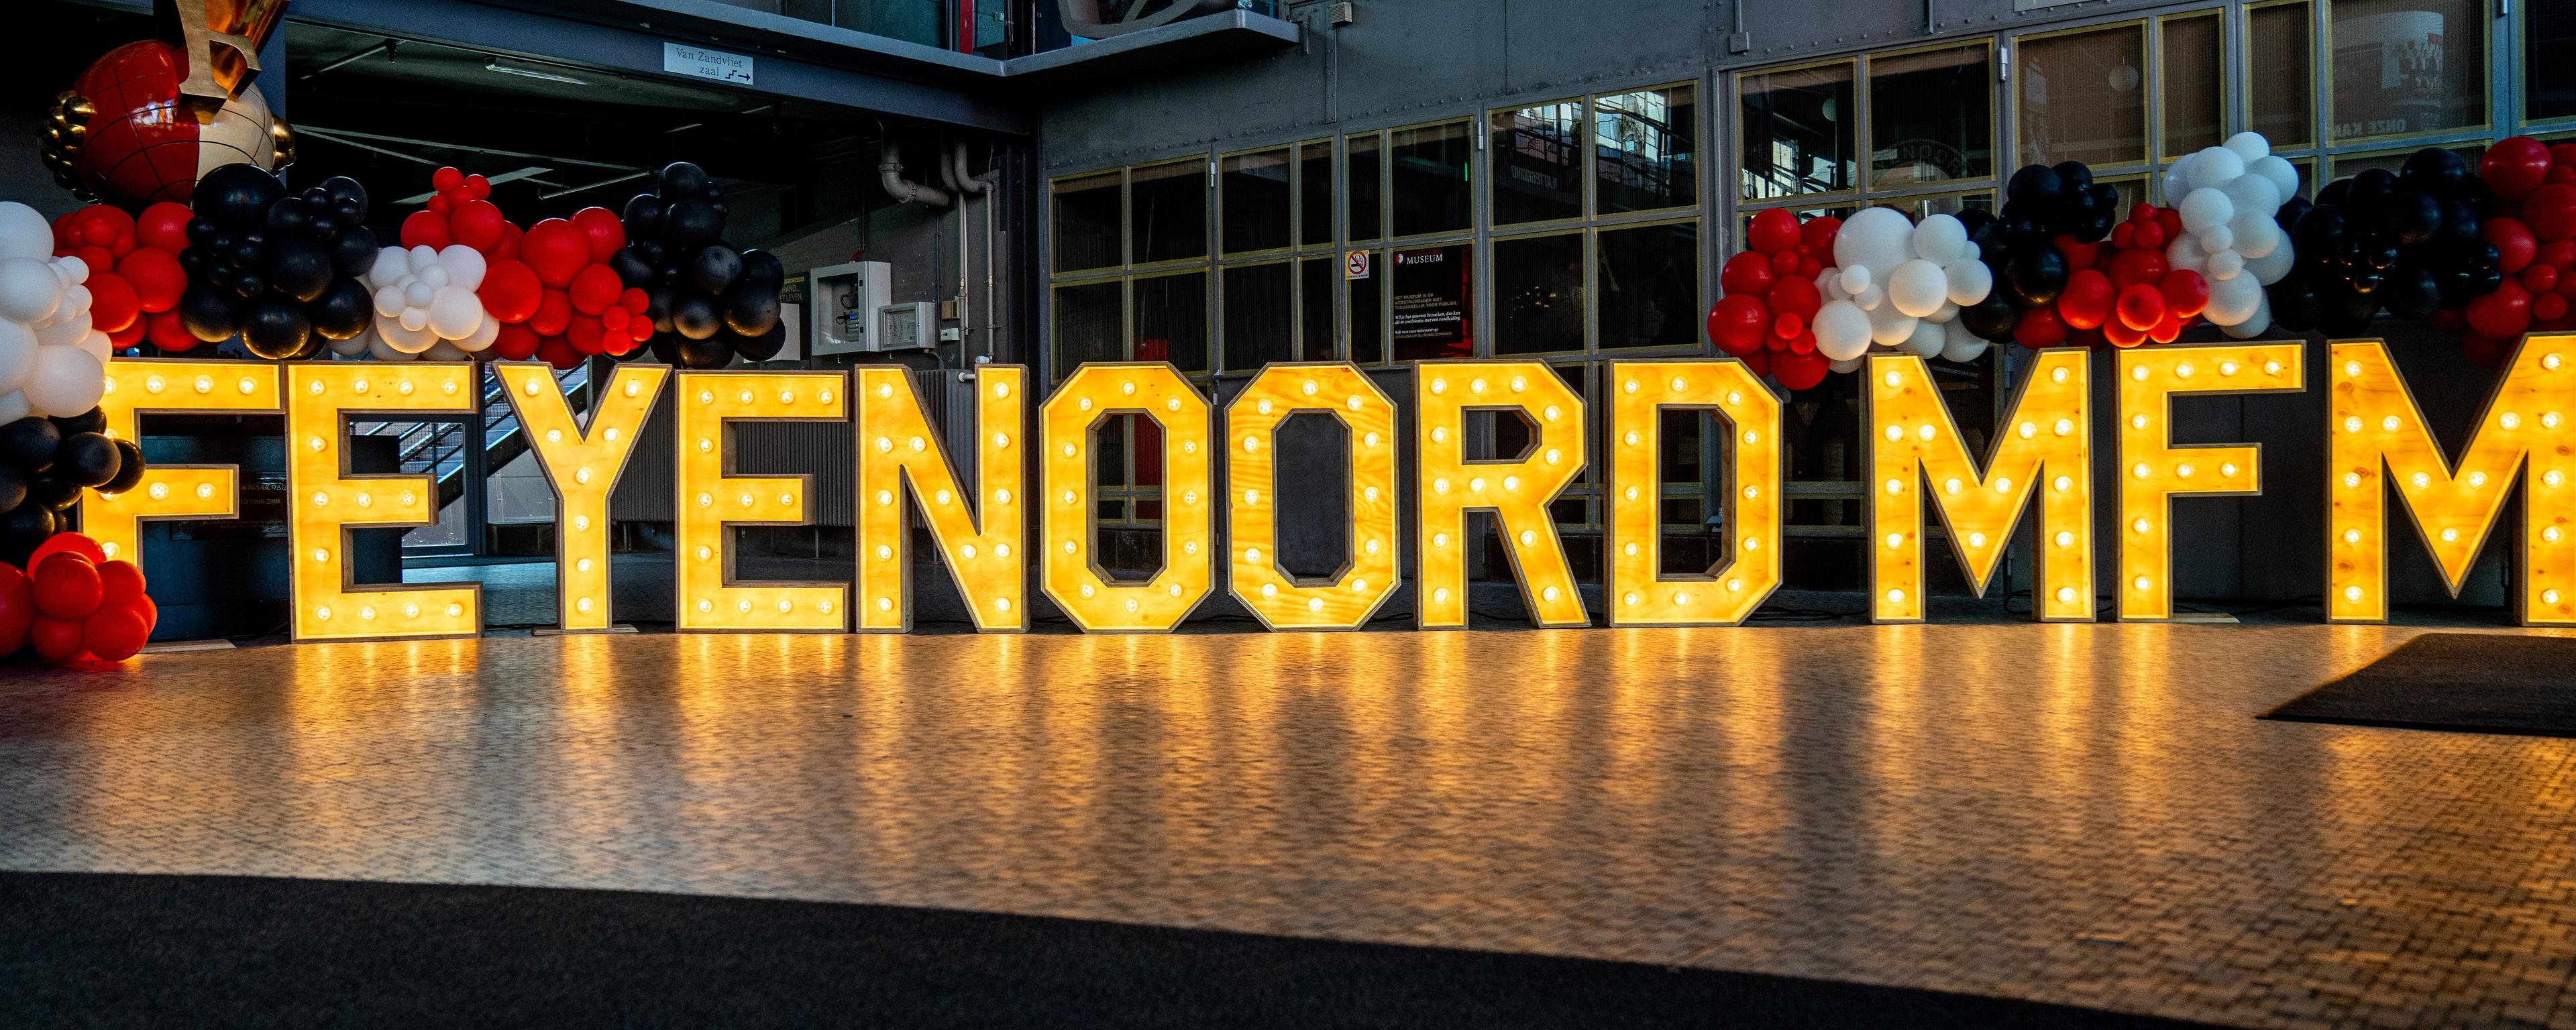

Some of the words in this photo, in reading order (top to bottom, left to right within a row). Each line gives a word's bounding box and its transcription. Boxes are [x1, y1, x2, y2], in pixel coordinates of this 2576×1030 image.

[676, 47, 694, 60] Van
[698, 52, 742, 68] Zandvliet
[700, 66, 719, 76] zaal
[1406, 253, 1443, 265] MUSEUM
[77, 357, 1784, 642] FEYENOORD
